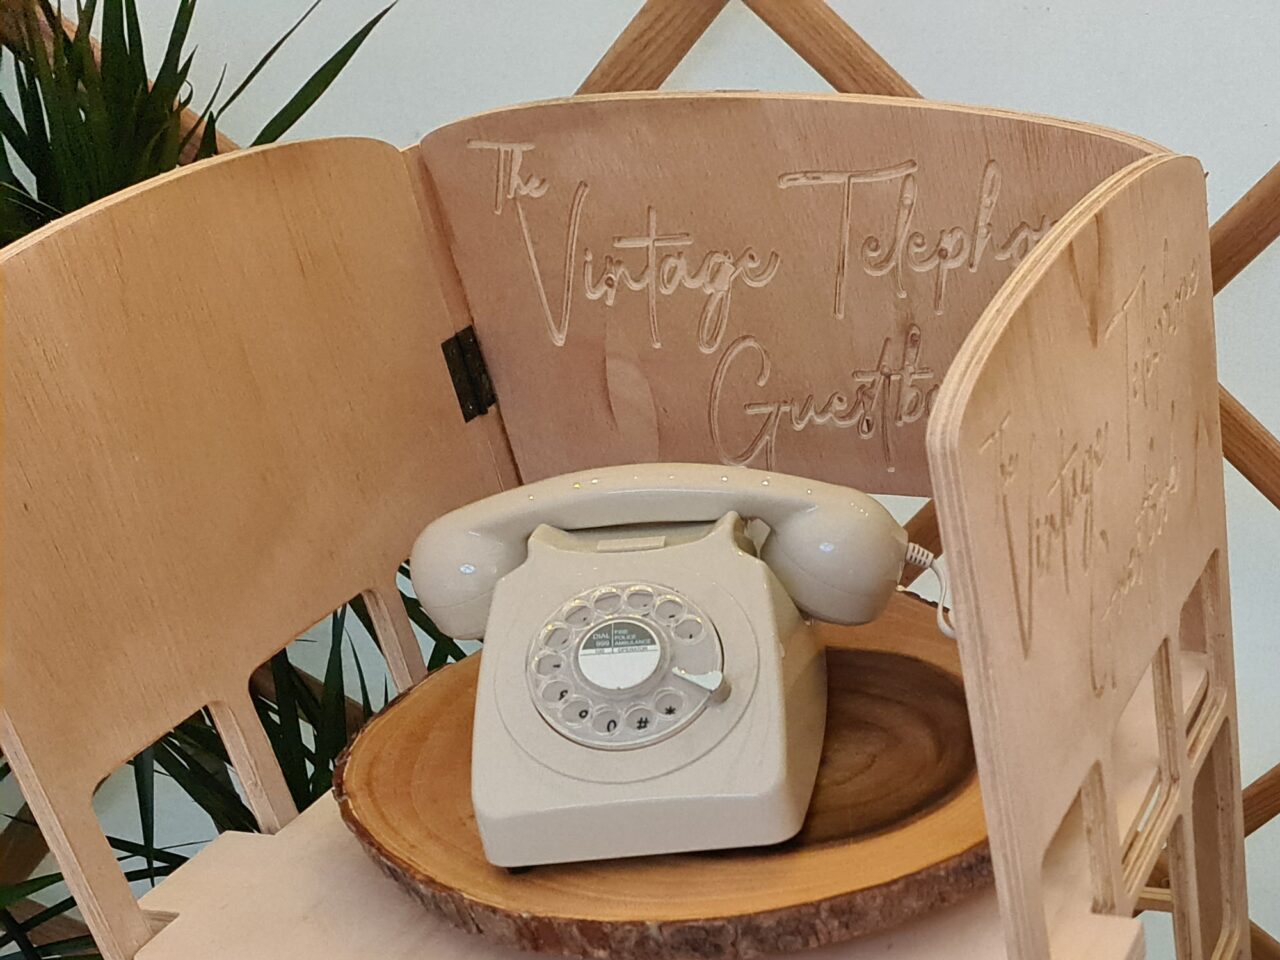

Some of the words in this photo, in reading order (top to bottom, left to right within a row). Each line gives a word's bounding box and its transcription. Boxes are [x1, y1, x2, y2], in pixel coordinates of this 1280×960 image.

[466, 139, 549, 215] The
[515, 180, 782, 353] Vintage
[776, 158, 1060, 320] Telepho
[592, 632, 610, 640] DIAL
